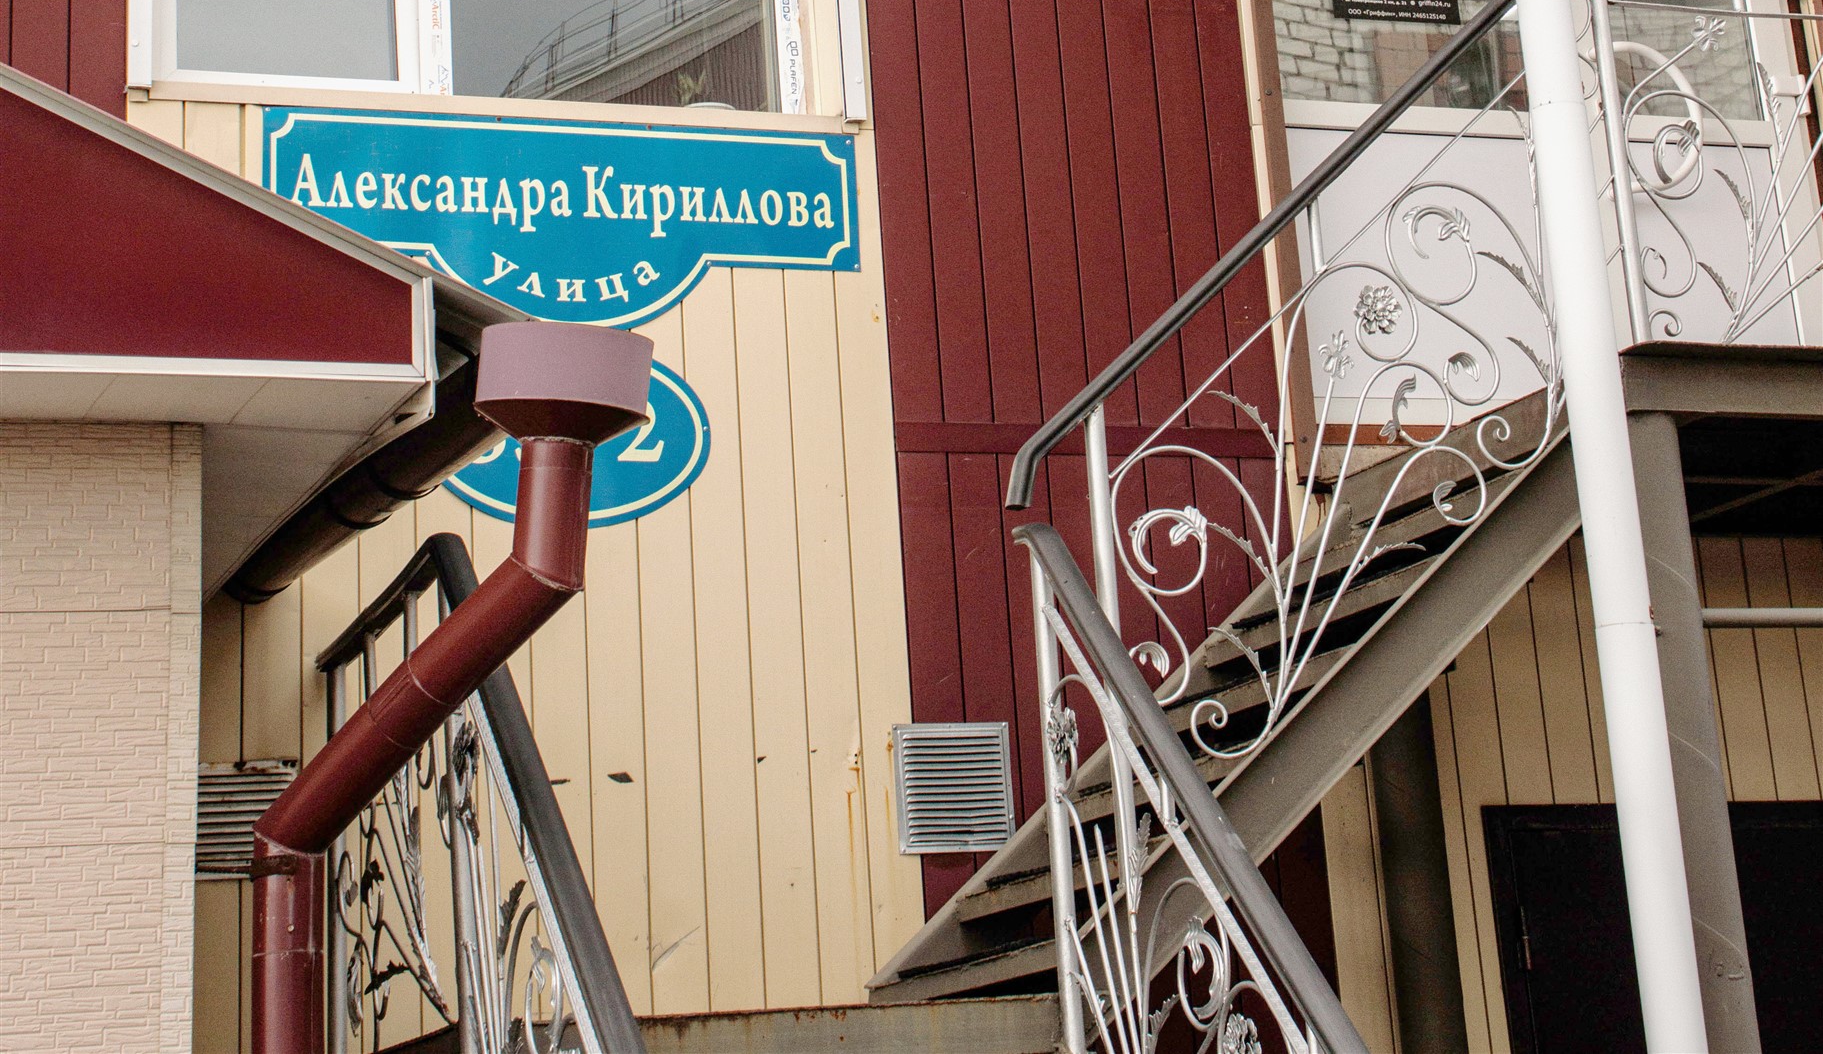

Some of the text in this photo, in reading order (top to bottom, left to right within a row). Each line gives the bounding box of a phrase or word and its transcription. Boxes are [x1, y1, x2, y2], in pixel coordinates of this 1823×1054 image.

[1418, 0, 1451, 8] griffin24.ru
[289, 152, 835, 238] Александра Кириллова
[482, 251, 661, 303] улица
